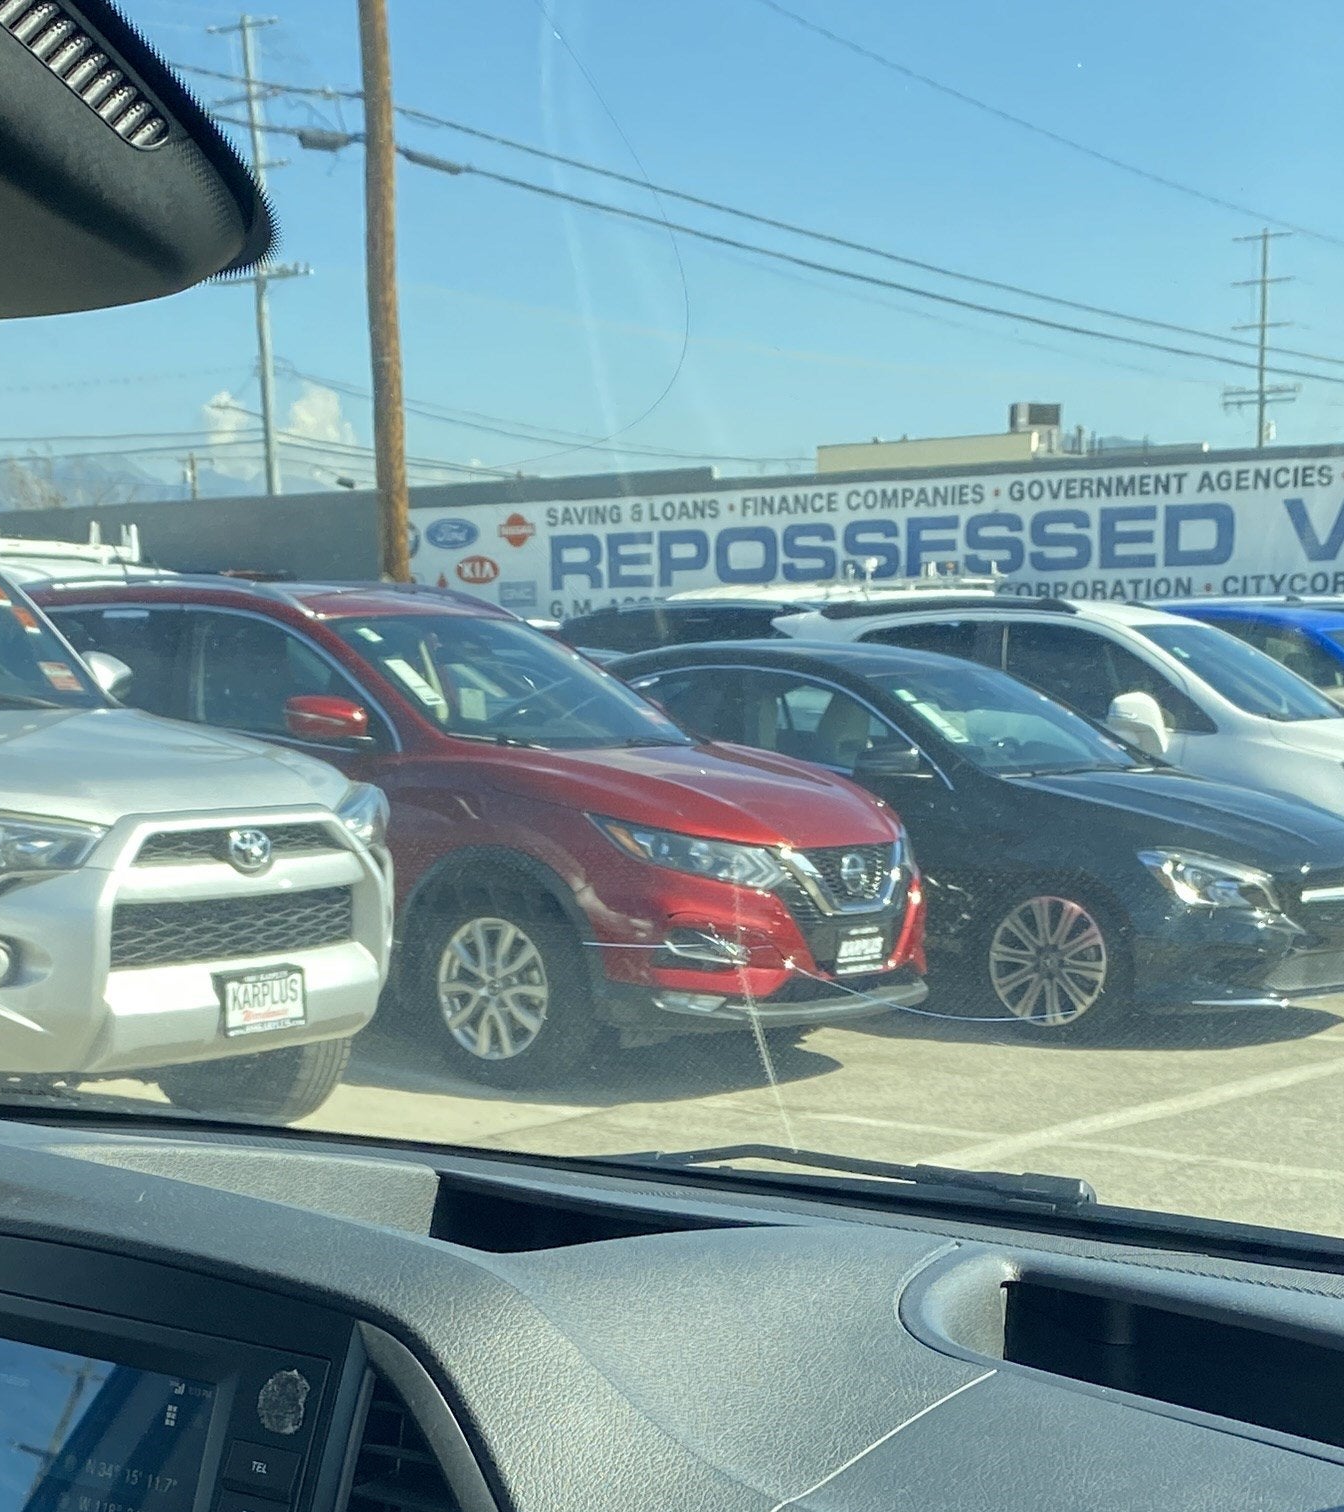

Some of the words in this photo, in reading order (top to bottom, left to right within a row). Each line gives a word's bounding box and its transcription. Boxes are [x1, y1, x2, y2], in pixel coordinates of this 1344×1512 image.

[546, 504, 622, 527] SAVING
[631, 504, 643, 522] &
[650, 499, 720, 522] LOANS
[741, 491, 839, 517] FINANCE
[847, 484, 985, 511] COMPANIES
[1009, 472, 1188, 502] GOVERNMENT
[1196, 464, 1333, 493] AGENCIES
[550, 503, 1235, 591] REPOSSESSED
[463, 561, 496, 578] KIA
[231, 978, 298, 1011] KARPLUS
[252, 1461, 267, 1474] TEL
